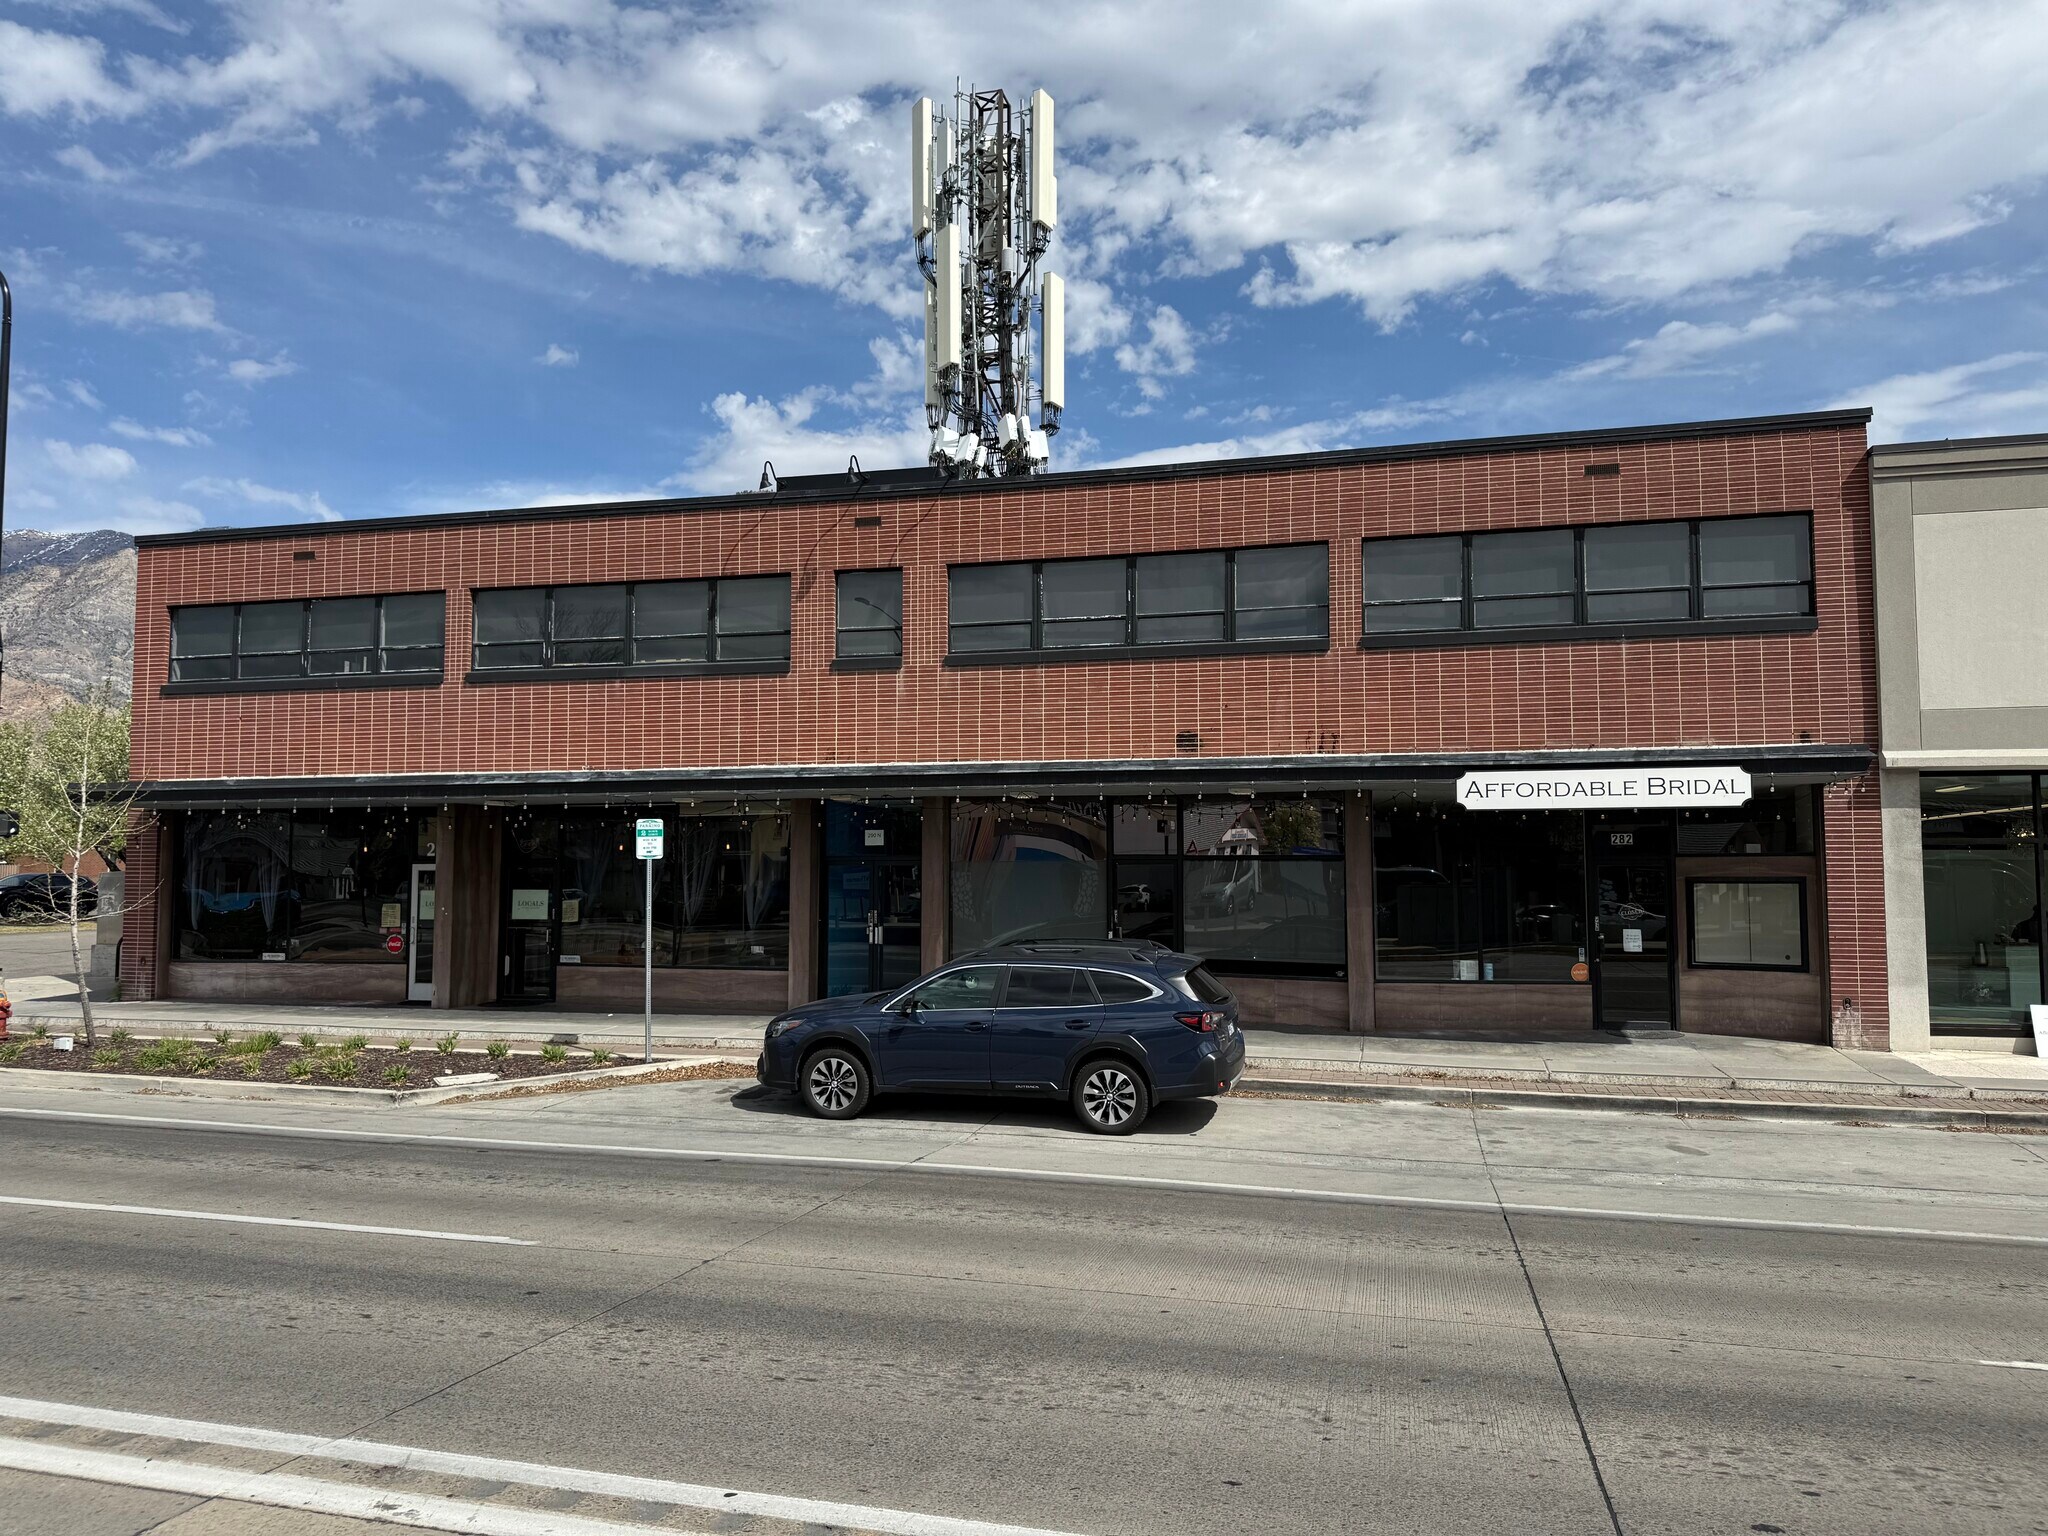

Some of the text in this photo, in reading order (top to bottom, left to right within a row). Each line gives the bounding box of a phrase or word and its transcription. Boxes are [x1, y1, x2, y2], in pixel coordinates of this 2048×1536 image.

[1464, 777, 1746, 799] AFFORDABLE BRIDAL
[1612, 834, 1633, 845] 282
